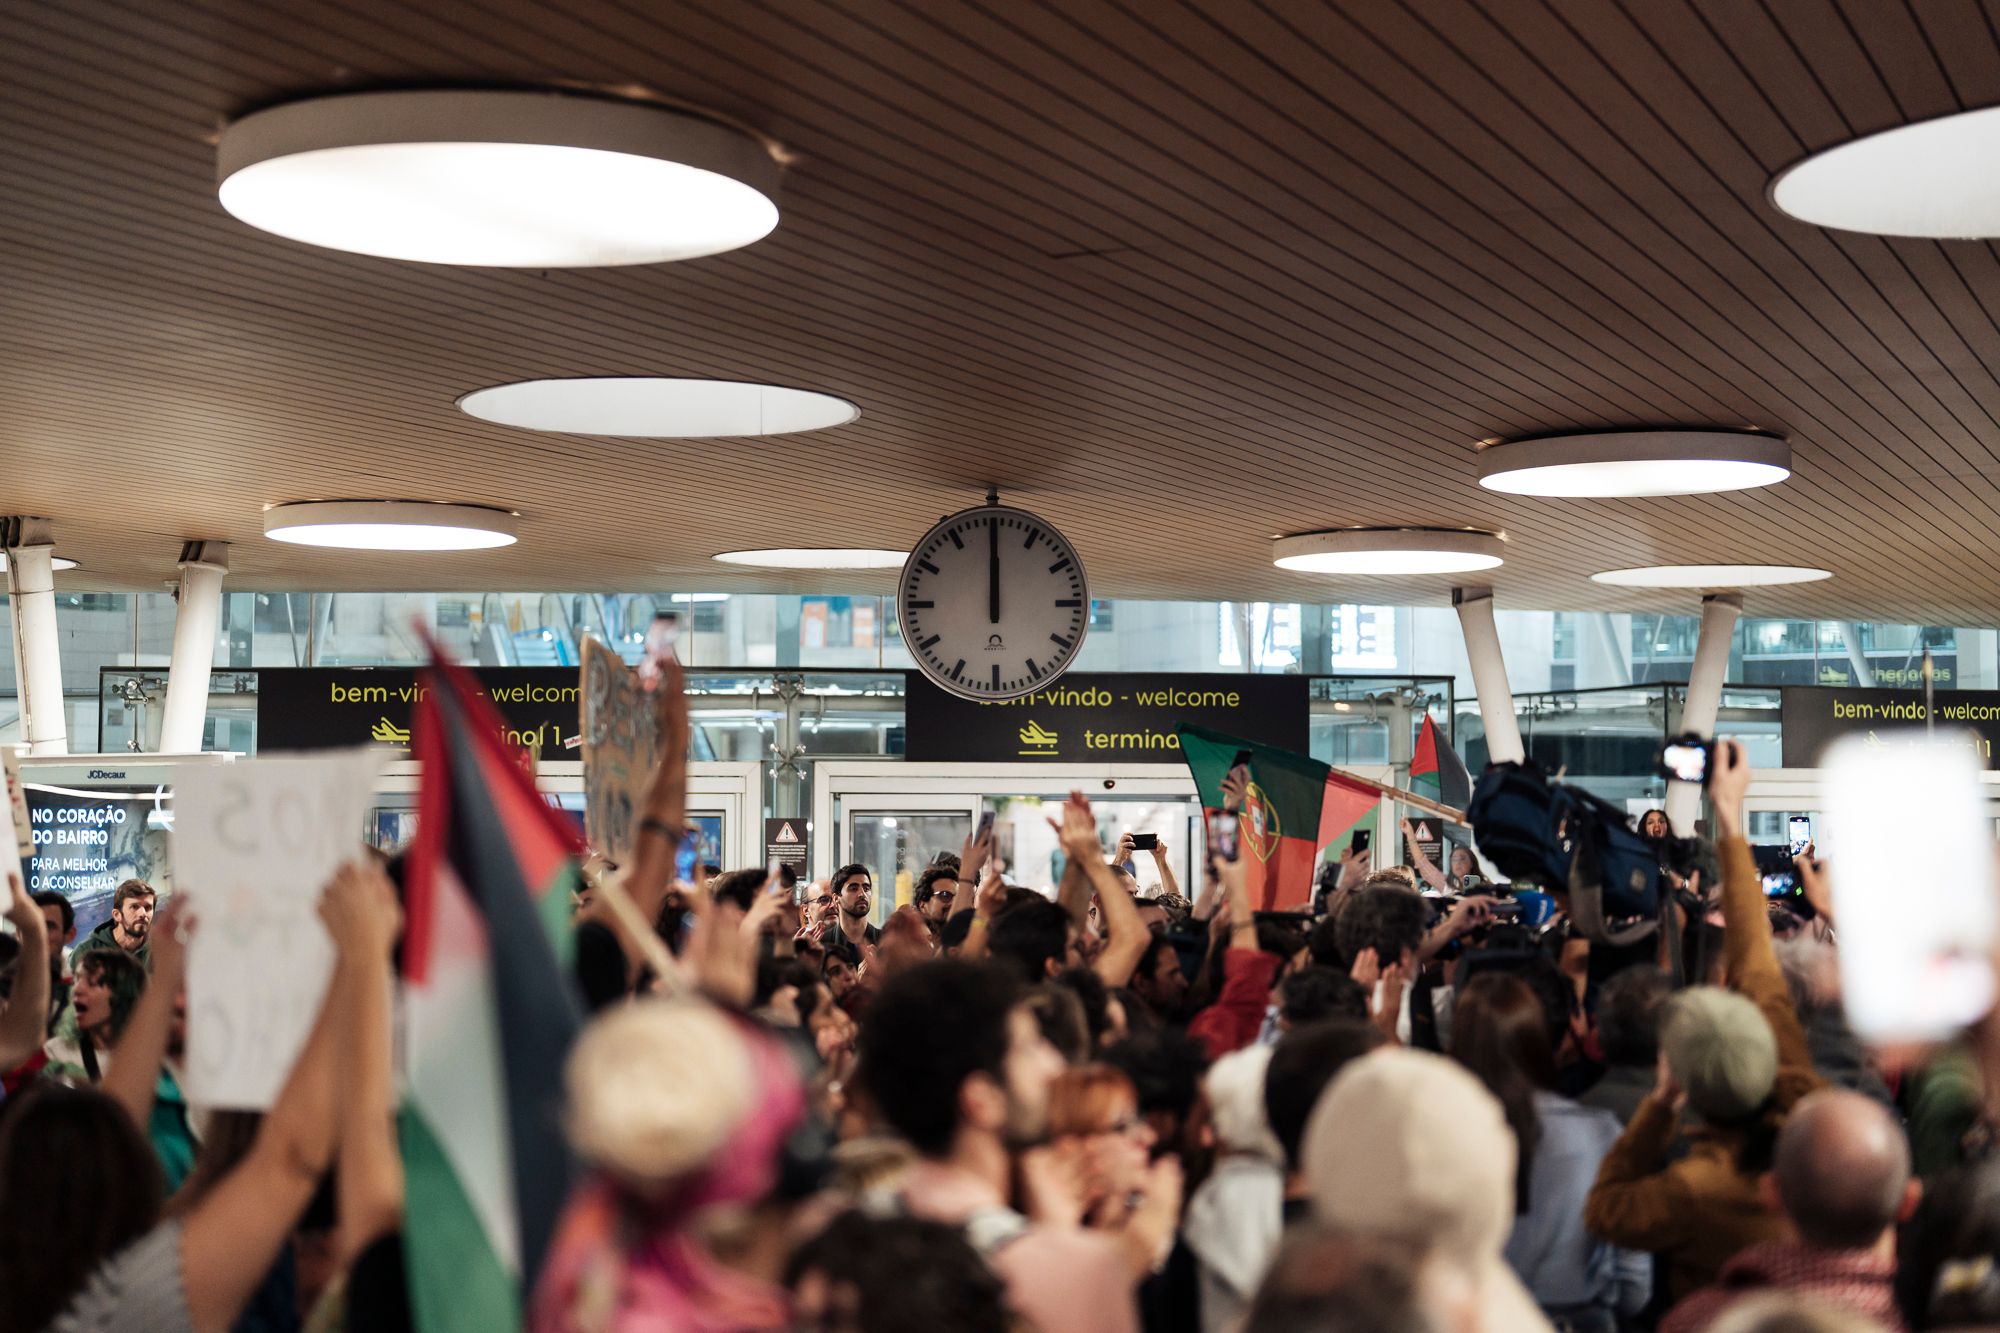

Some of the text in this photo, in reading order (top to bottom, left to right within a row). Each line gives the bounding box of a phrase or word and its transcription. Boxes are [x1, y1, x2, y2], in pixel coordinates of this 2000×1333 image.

[491, 682, 581, 703] welcom
[1135, 686, 1240, 708] welcome
[1833, 699, 1927, 720] bem-vindo
[1943, 702, 2000, 720] welcom
[553, 726, 560, 746] 1
[1084, 728, 1180, 749] termina
[1985, 739, 1991, 758] 1
[87, 770, 126, 780] JCDecaux
[32, 804, 127, 828] NO CORAÇÃO
[32, 829, 109, 846] DO BAIRRO
[31, 858, 108, 872] PARA MELHOR
[30, 875, 115, 890] O ACONSELHAR
